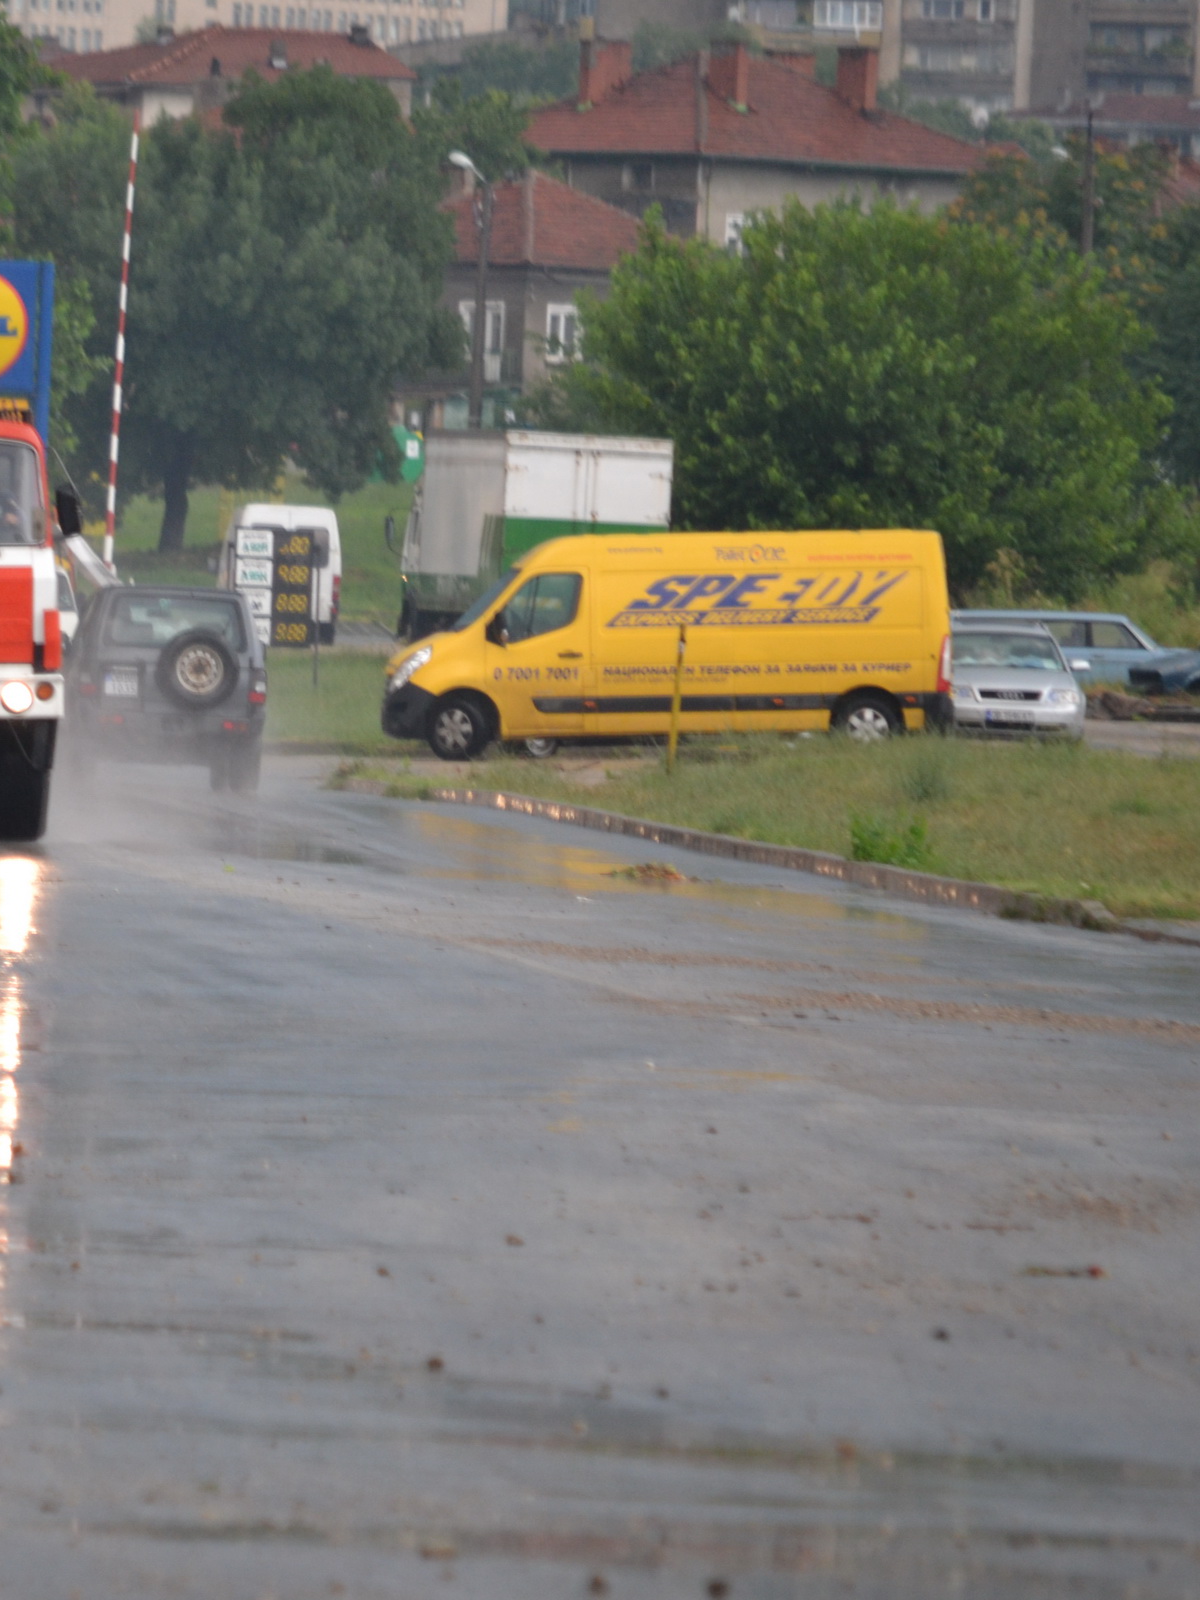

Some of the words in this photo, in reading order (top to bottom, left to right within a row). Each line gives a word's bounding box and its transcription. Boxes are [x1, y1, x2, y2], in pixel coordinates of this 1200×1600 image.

[624, 570, 910, 611] SPEEDY
[507, 667, 540, 680] 7001
[545, 666, 579, 680] 7001
[603, 665, 695, 676] НАЦИОНАЛН
